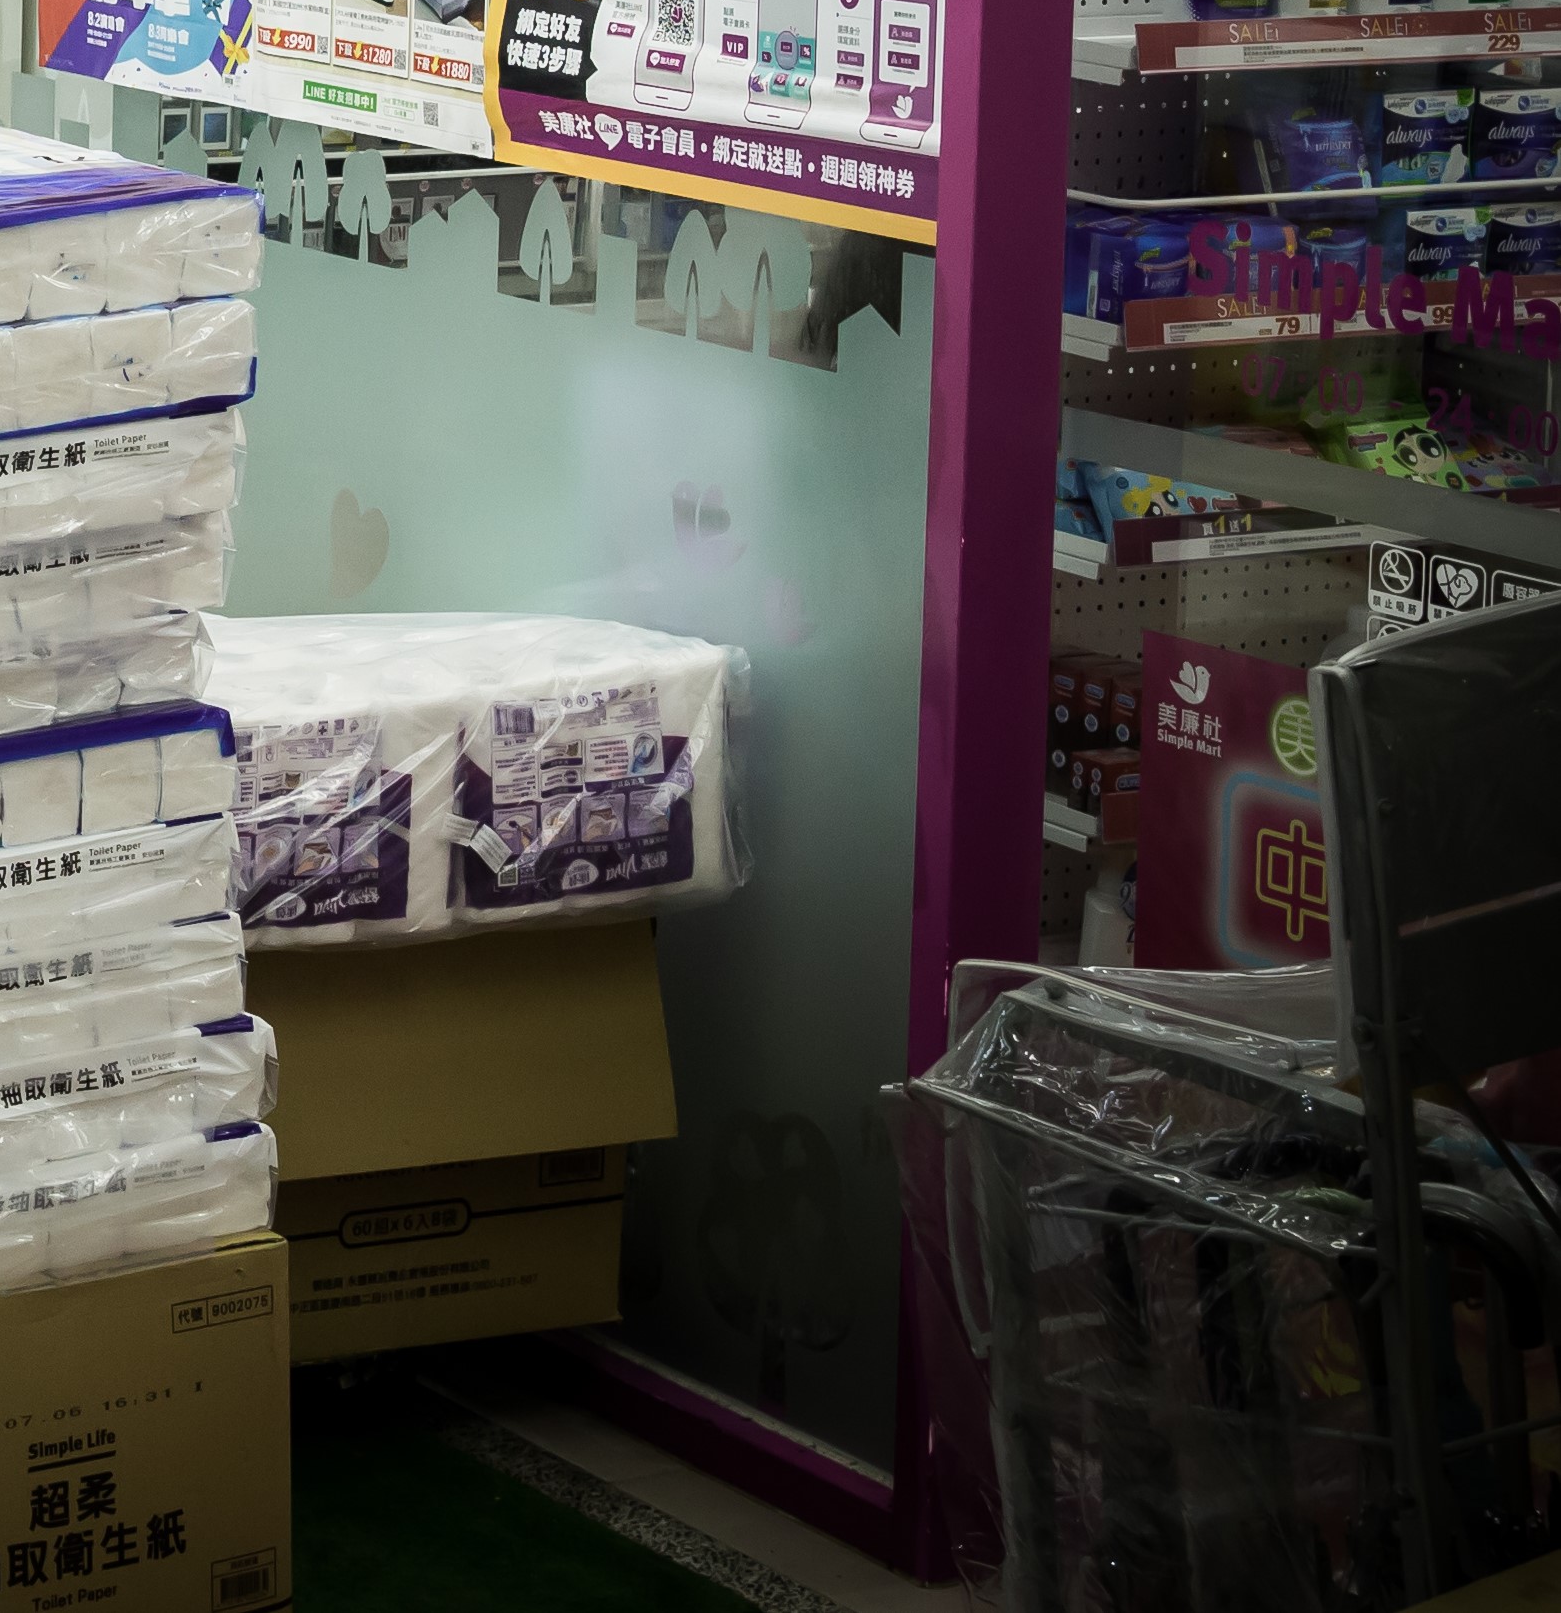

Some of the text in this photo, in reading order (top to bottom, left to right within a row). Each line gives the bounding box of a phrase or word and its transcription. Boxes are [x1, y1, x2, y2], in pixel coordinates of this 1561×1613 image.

[515, 7, 582, 42] 綁定好友
[284, 35, 312, 50] $990
[727, 41, 744, 54] VIP
[1488, 35, 1520, 51] 229
[363, 47, 391, 65] $1280
[441, 62, 469, 80] $1880
[305, 85, 326, 99] LINE
[538, 110, 619, 140] 美廉社 LINE
[1386, 125, 1433, 147] always
[1488, 121, 1535, 144] always
[1408, 244, 1452, 265] always
[1497, 236, 1542, 257] always
[1187, 221, 1425, 339] Simple
[1276, 317, 1300, 334] 79
[1242, 354, 1558, 456] 07:00 24:00
[94, 436, 119, 448] Toilet
[121, 432, 146, 446] Paper
[1157, 703, 1222, 743] 美廉社
[1157, 730, 1222, 758] Simple Mart
[89, 845, 113, 857] Toilet
[116, 842, 142, 855] Paper
[1257, 819, 1329, 942] 中
[127, 1056, 150, 1067] Toilet
[152, 1051, 176, 1062] Paper
[212, 1294, 268, 1319] 9002075
[28, 1428, 116, 1462] Simple Life
[30, 1471, 117, 1531] 超柔
[78, 1583, 117, 1606] Paper
